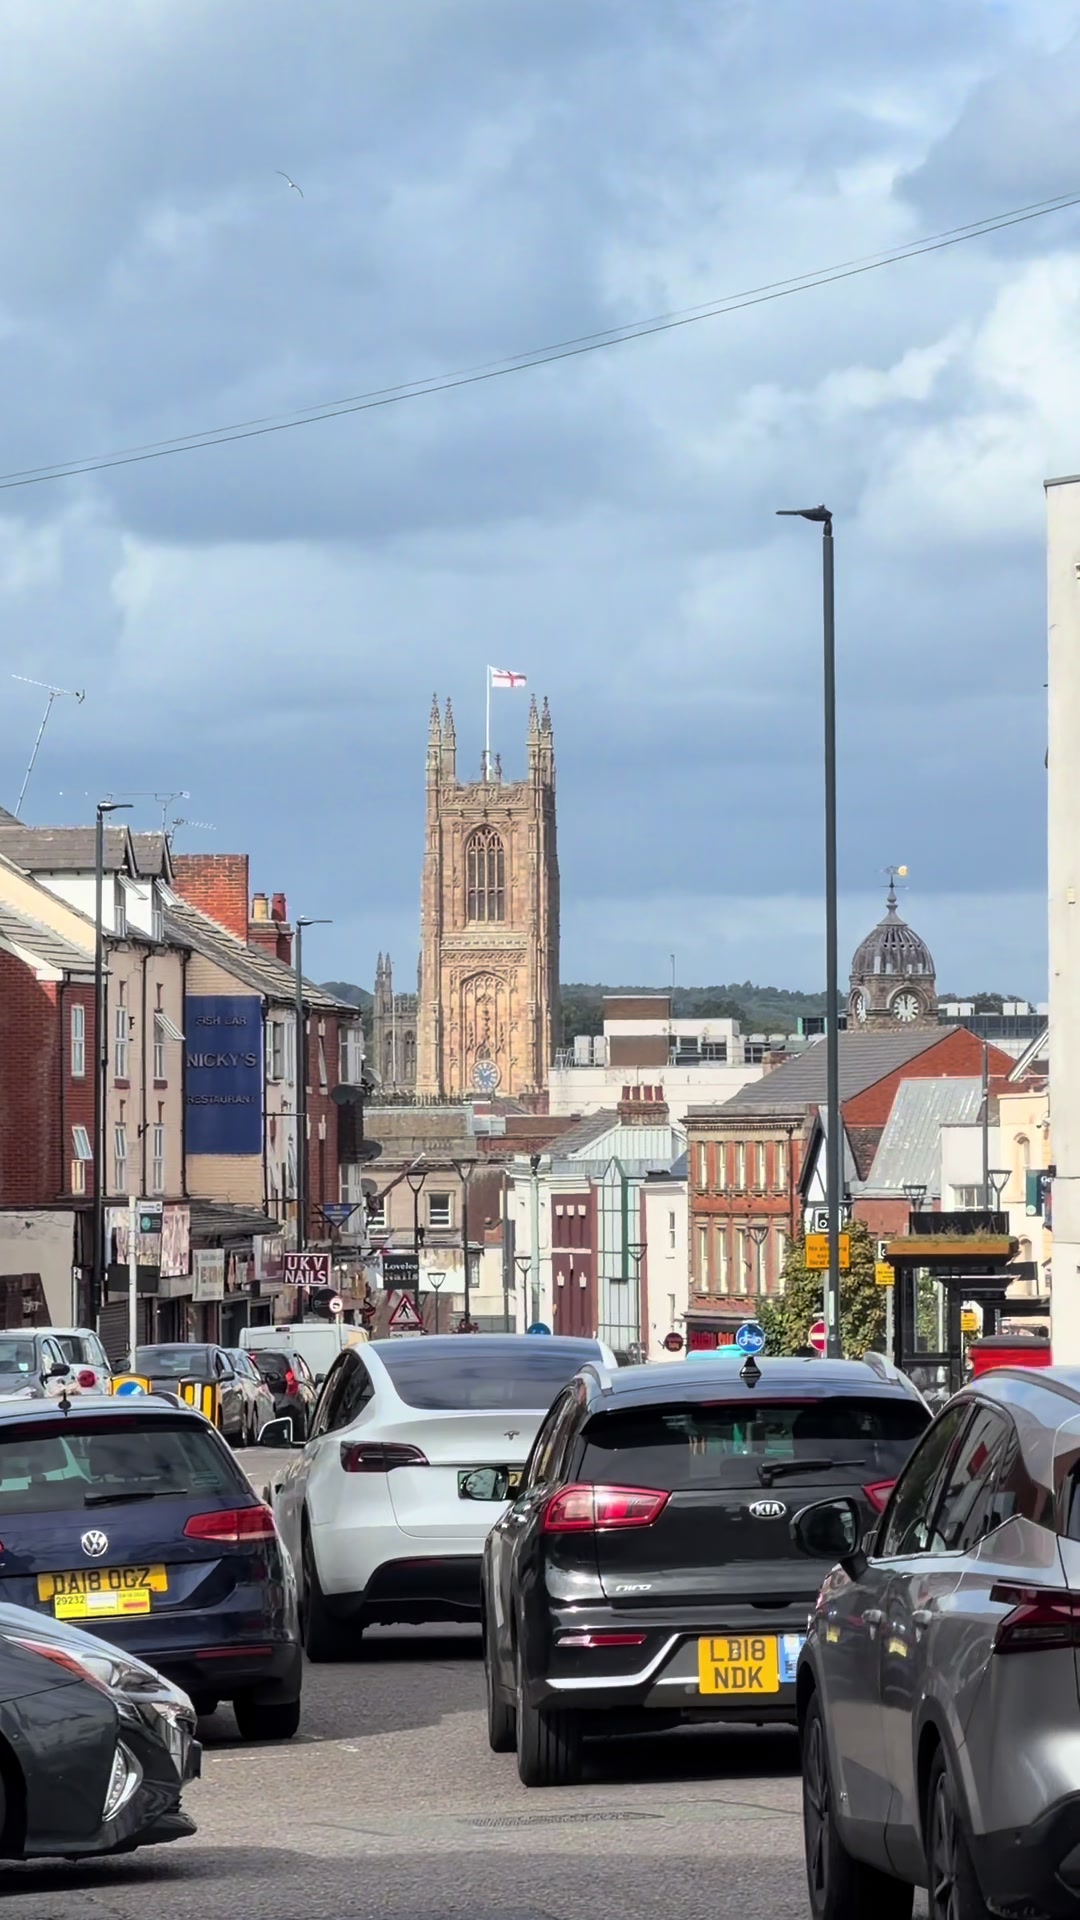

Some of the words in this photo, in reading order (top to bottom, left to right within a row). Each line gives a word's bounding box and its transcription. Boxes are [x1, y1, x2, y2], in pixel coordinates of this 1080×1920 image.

[196, 1016, 221, 1026] FISH
[186, 1053, 257, 1068] NICKY'S
[187, 1095, 256, 1105] RESTAURANT
[384, 1262, 419, 1270] Lovelee
[284, 1270, 327, 1284] NAILS
[384, 1271, 419, 1280] Nails
[754, 1502, 782, 1516] KIA
[56, 1595, 85, 1605] 29232
[714, 1667, 763, 1689] NDK
